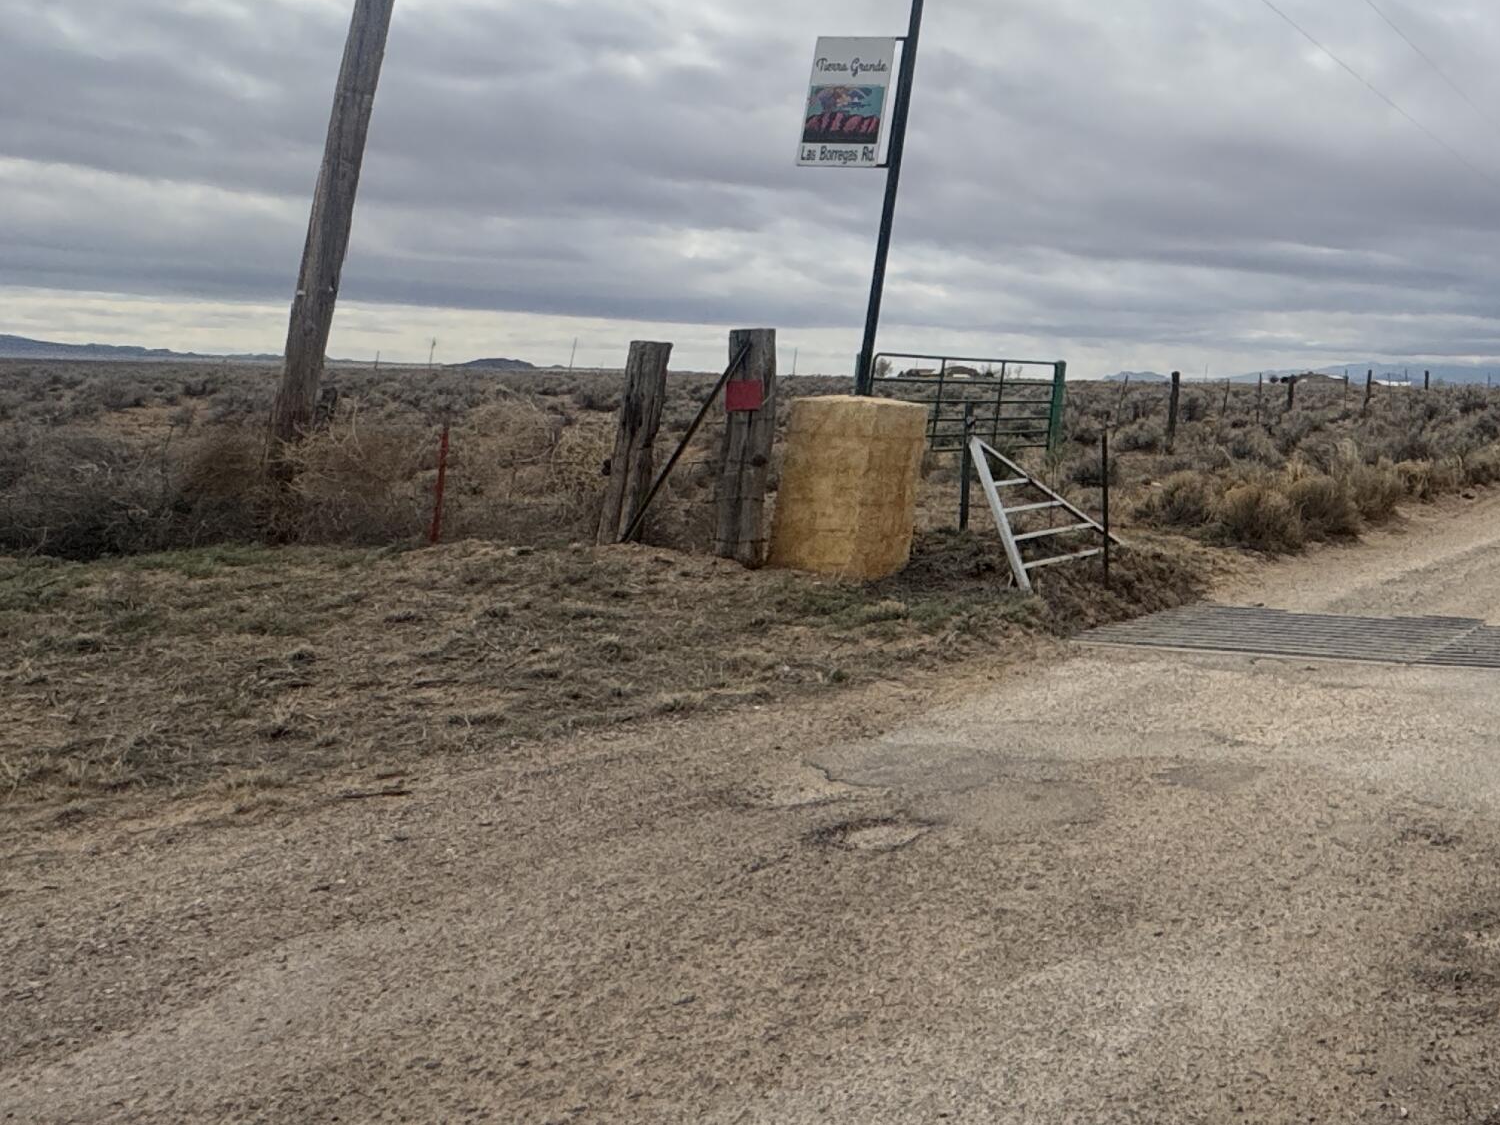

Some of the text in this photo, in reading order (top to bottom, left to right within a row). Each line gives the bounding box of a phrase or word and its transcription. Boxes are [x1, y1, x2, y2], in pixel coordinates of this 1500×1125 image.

[816, 57, 888, 78] Tierra Grande
[800, 146, 817, 161] Las
[819, 145, 858, 165] Borregas
